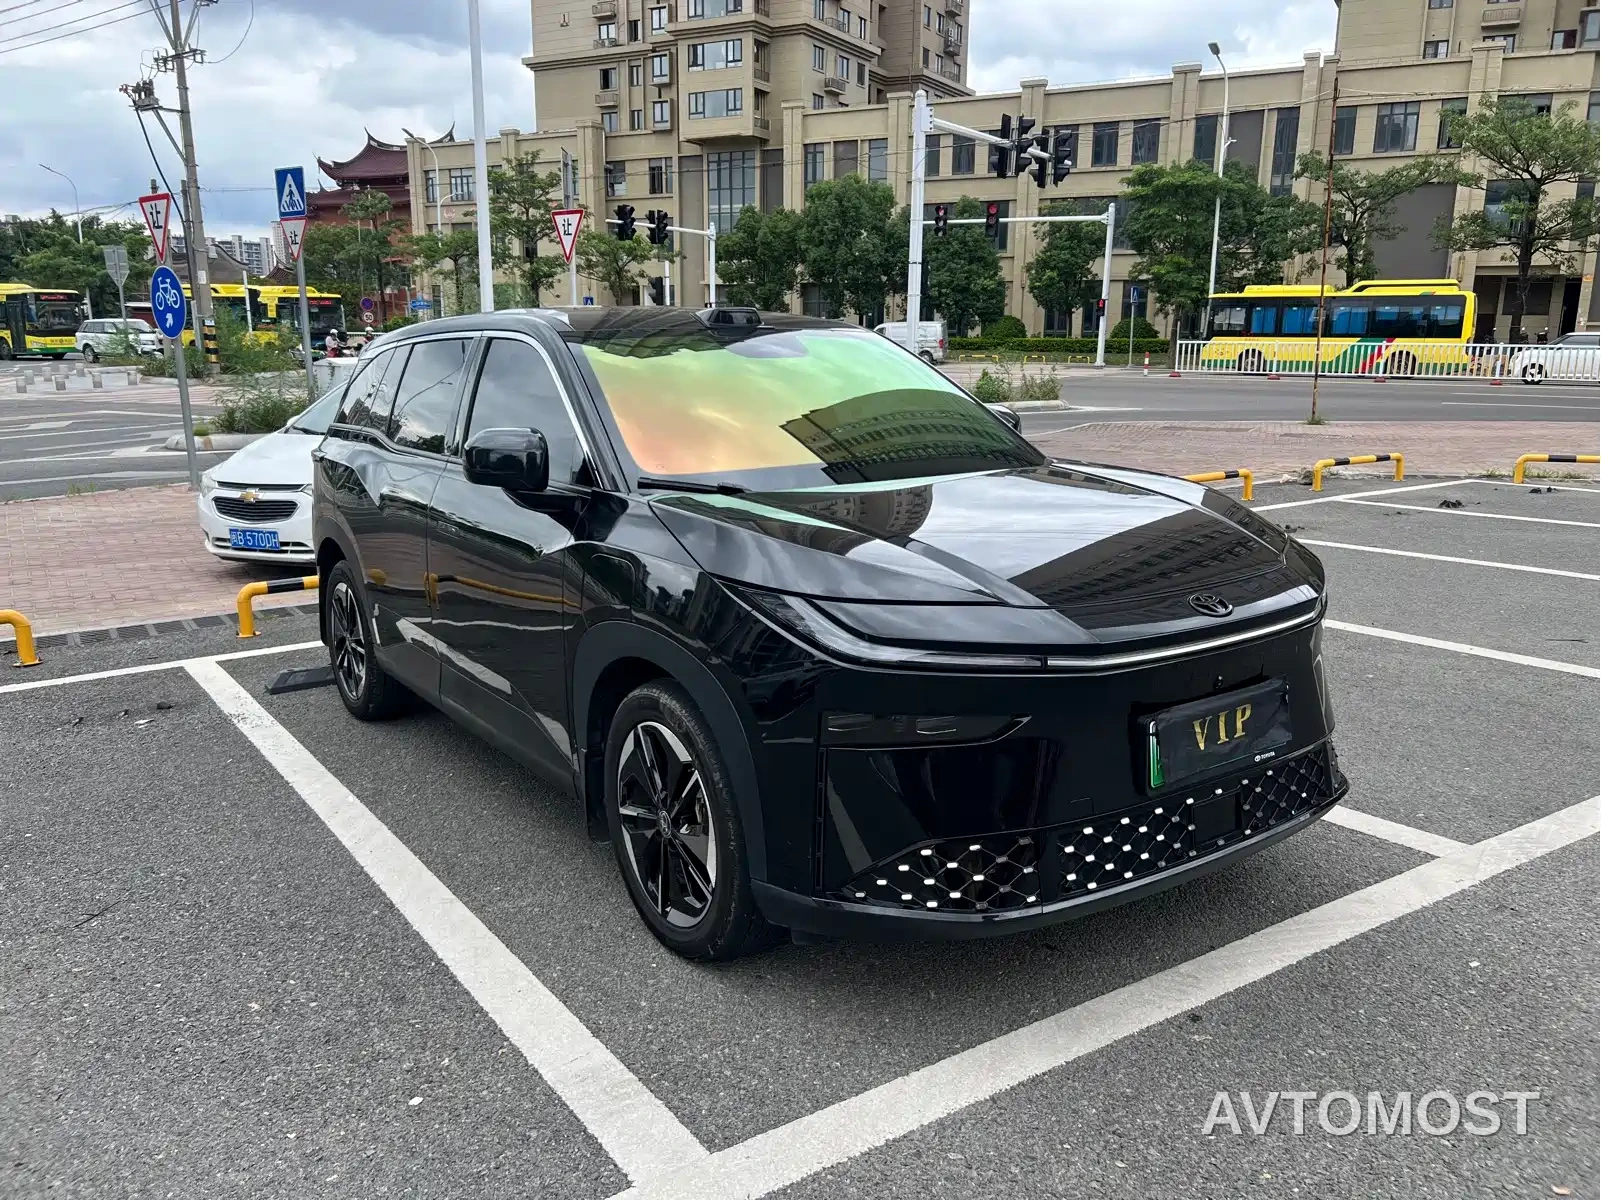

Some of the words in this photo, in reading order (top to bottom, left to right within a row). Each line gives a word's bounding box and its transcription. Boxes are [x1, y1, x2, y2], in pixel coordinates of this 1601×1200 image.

[149, 203, 163, 229] 让
[562, 218, 573, 236] 让
[290, 230, 299, 245] 让
[1193, 703, 1252, 750] VIP
